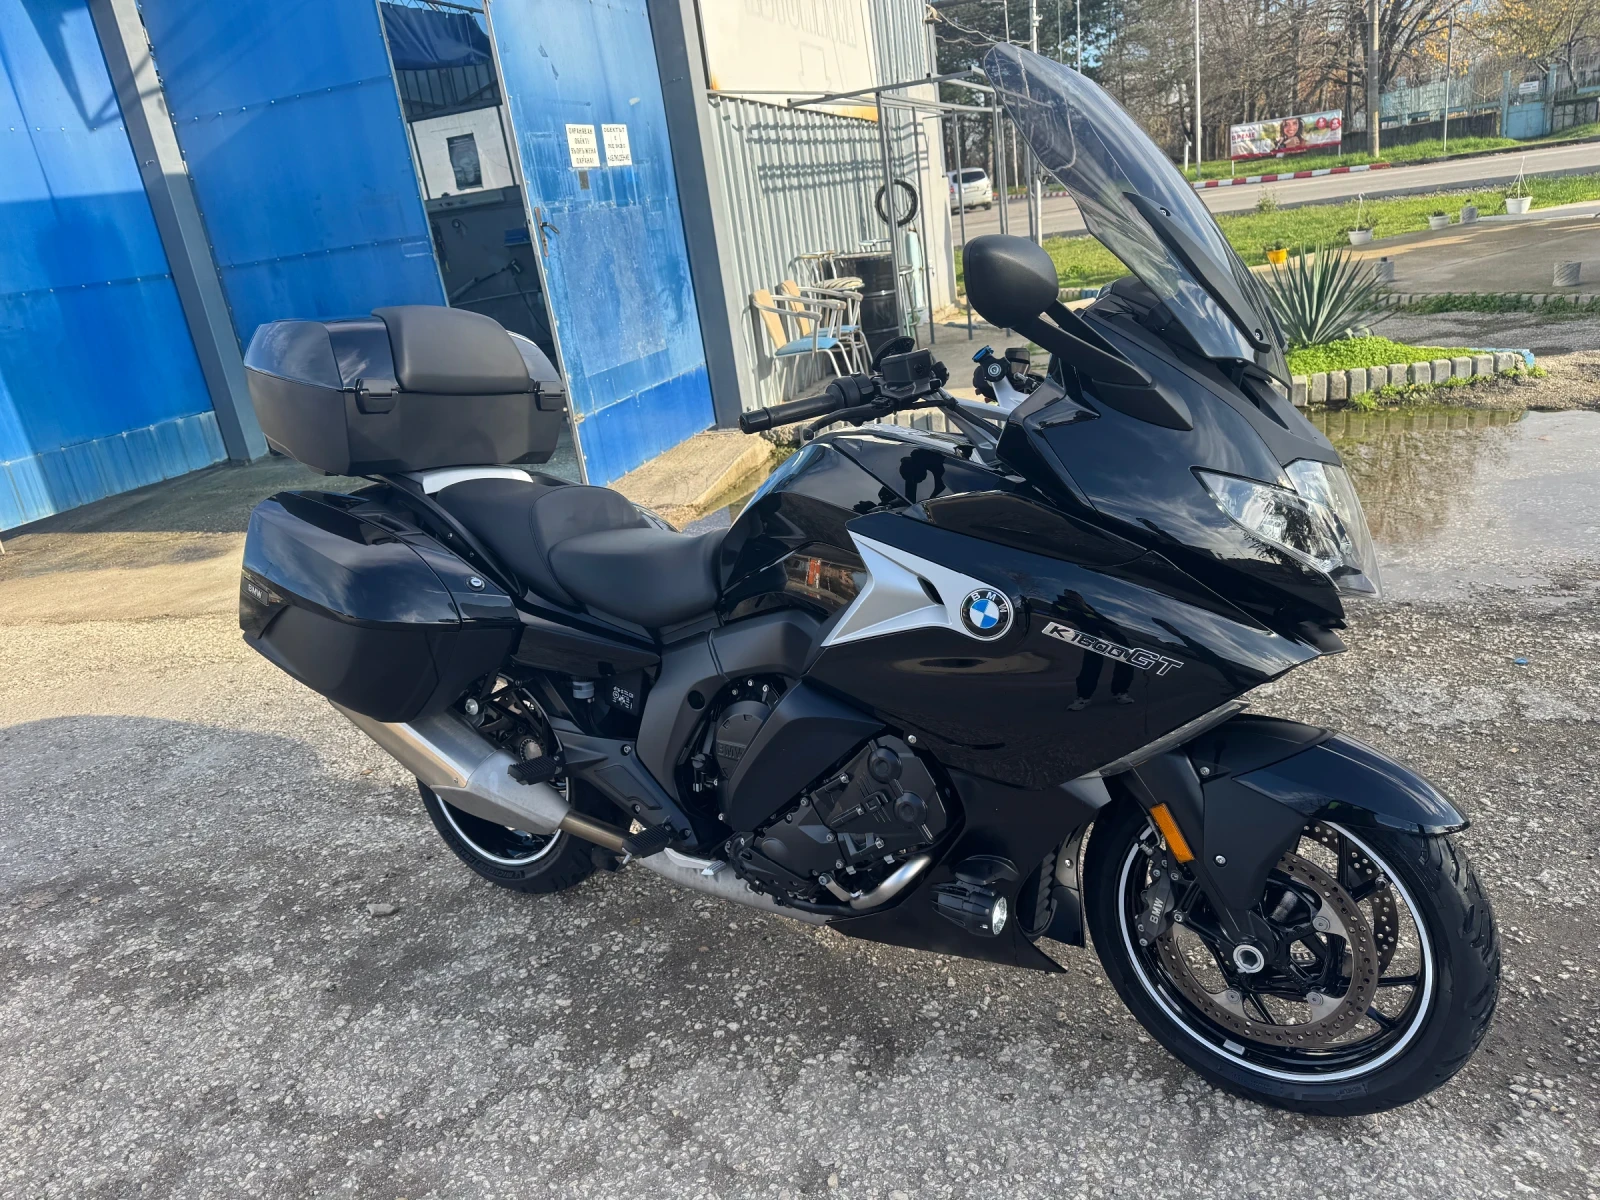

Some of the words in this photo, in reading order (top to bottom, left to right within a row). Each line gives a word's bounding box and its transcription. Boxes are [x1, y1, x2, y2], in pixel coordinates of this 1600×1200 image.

[248, 583, 263, 599] BMW
[970, 591, 1008, 613] BMW
[1149, 897, 1164, 924] BMW
